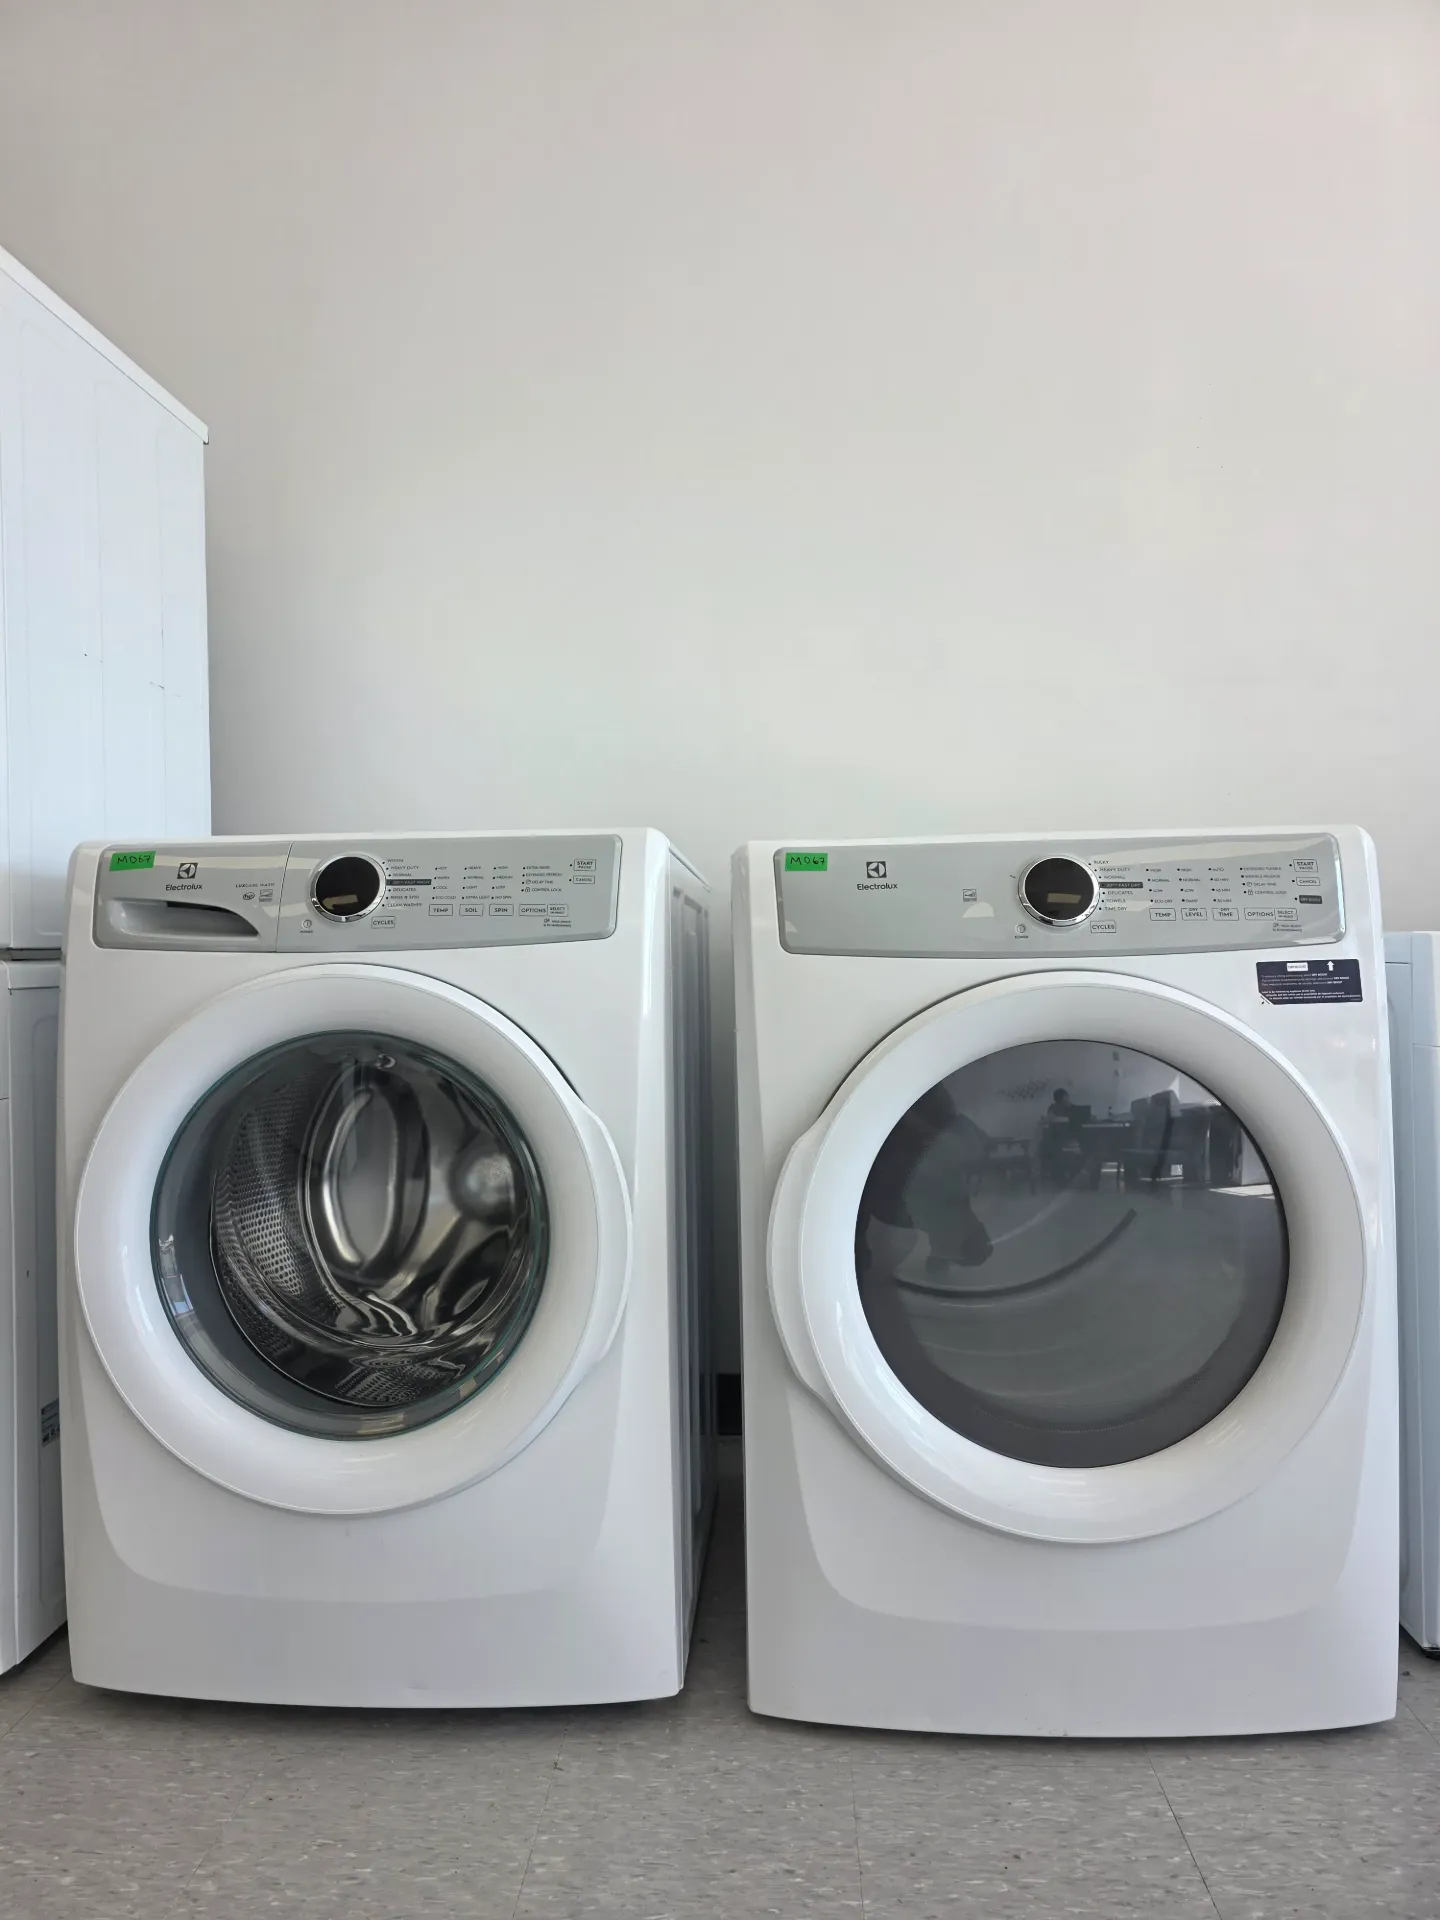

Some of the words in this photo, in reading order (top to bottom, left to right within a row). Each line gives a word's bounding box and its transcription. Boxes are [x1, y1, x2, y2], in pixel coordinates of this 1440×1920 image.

[117, 855, 151, 864] M067
[790, 856, 825, 865] M067
[857, 883, 898, 891] Electrolux
